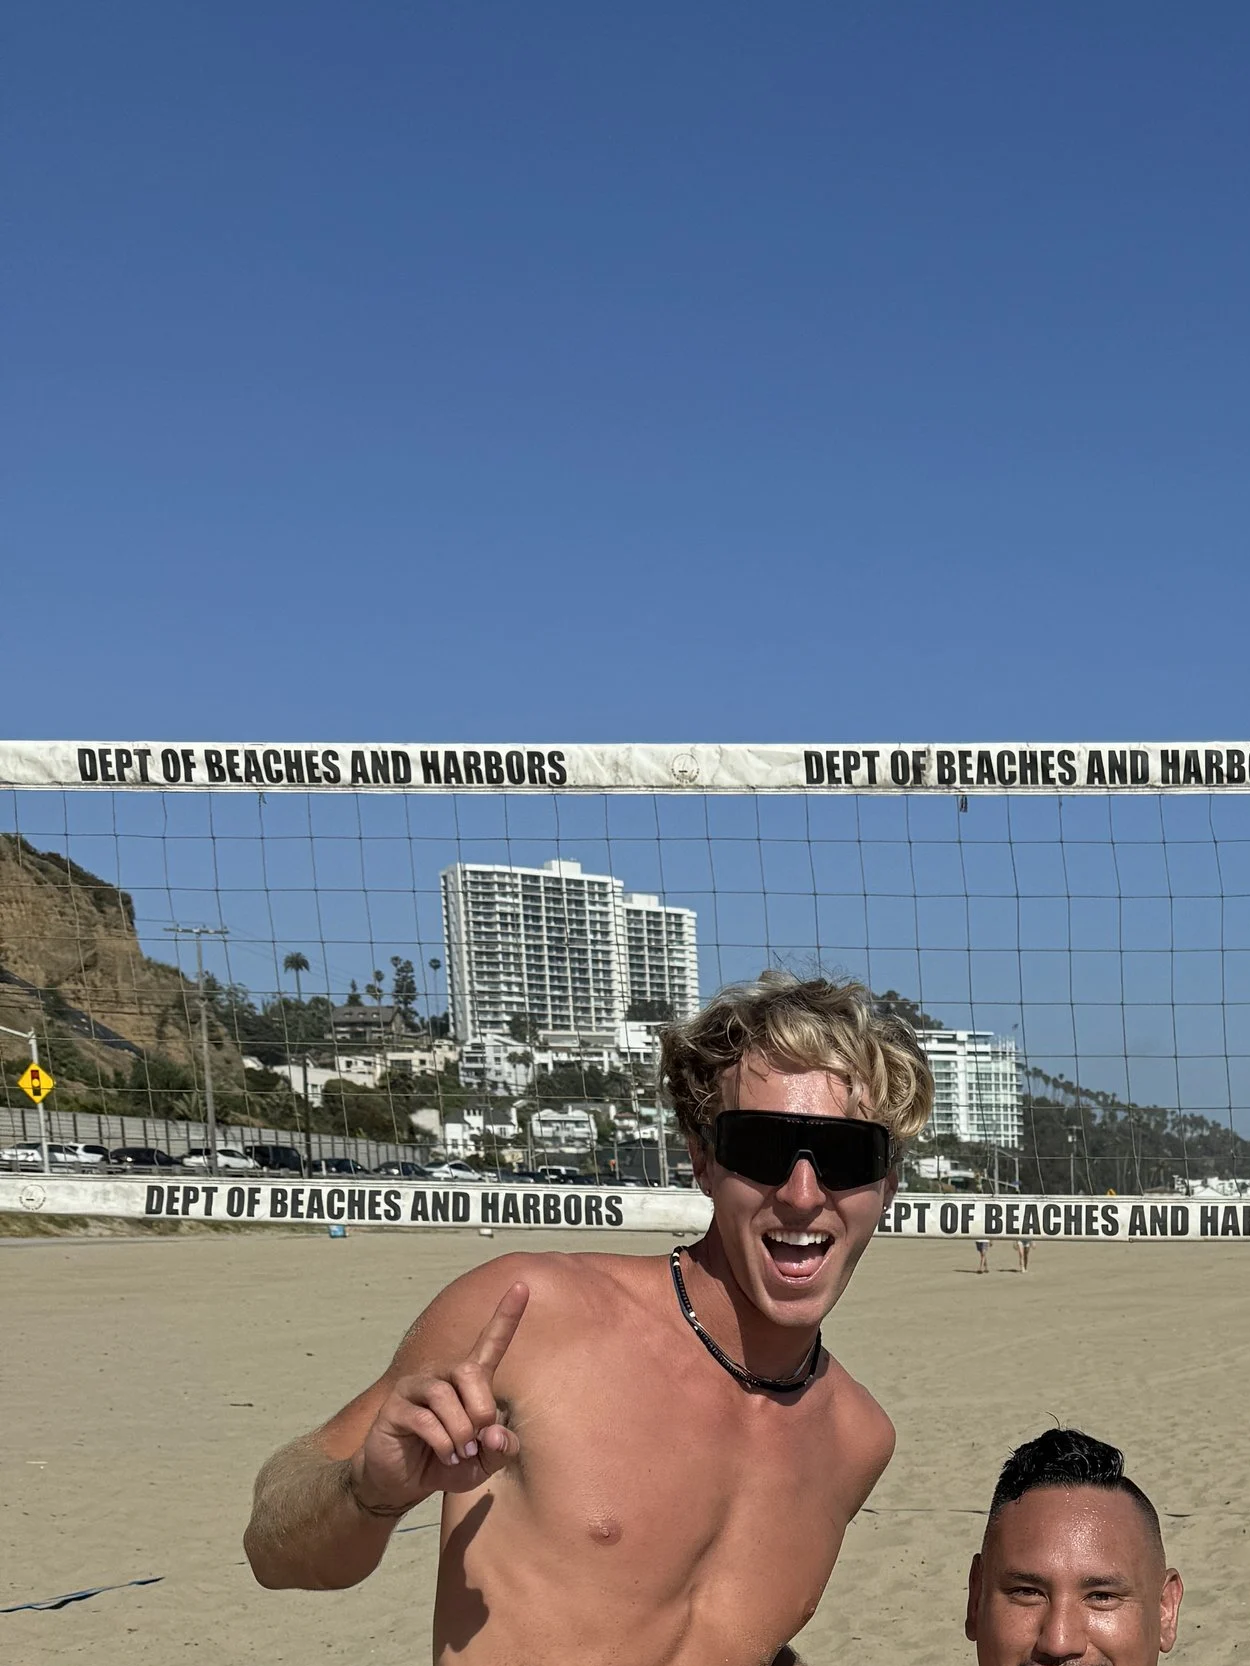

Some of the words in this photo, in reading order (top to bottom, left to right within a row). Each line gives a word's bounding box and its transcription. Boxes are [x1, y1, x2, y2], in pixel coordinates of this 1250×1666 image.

[77, 748, 151, 782] DEPT
[161, 749, 197, 783] OF
[205, 749, 341, 784] BEACHES
[349, 750, 411, 785] AND
[420, 750, 567, 786] HARBORS
[804, 750, 879, 785] DEPT
[891, 750, 927, 785] OF
[937, 750, 1077, 785] BEACHES
[1087, 750, 1149, 785] AND
[145, 1185, 218, 1217] DEPT
[226, 1186, 261, 1219] OF
[270, 1187, 402, 1223] BEACHES
[410, 1190, 470, 1225] AND
[480, 1191, 624, 1227] HARBORS
[878, 1202, 931, 1235] EPT
[940, 1202, 975, 1236] OF
[984, 1202, 1120, 1237] BEACHES
[1128, 1203, 1190, 1238] AND
